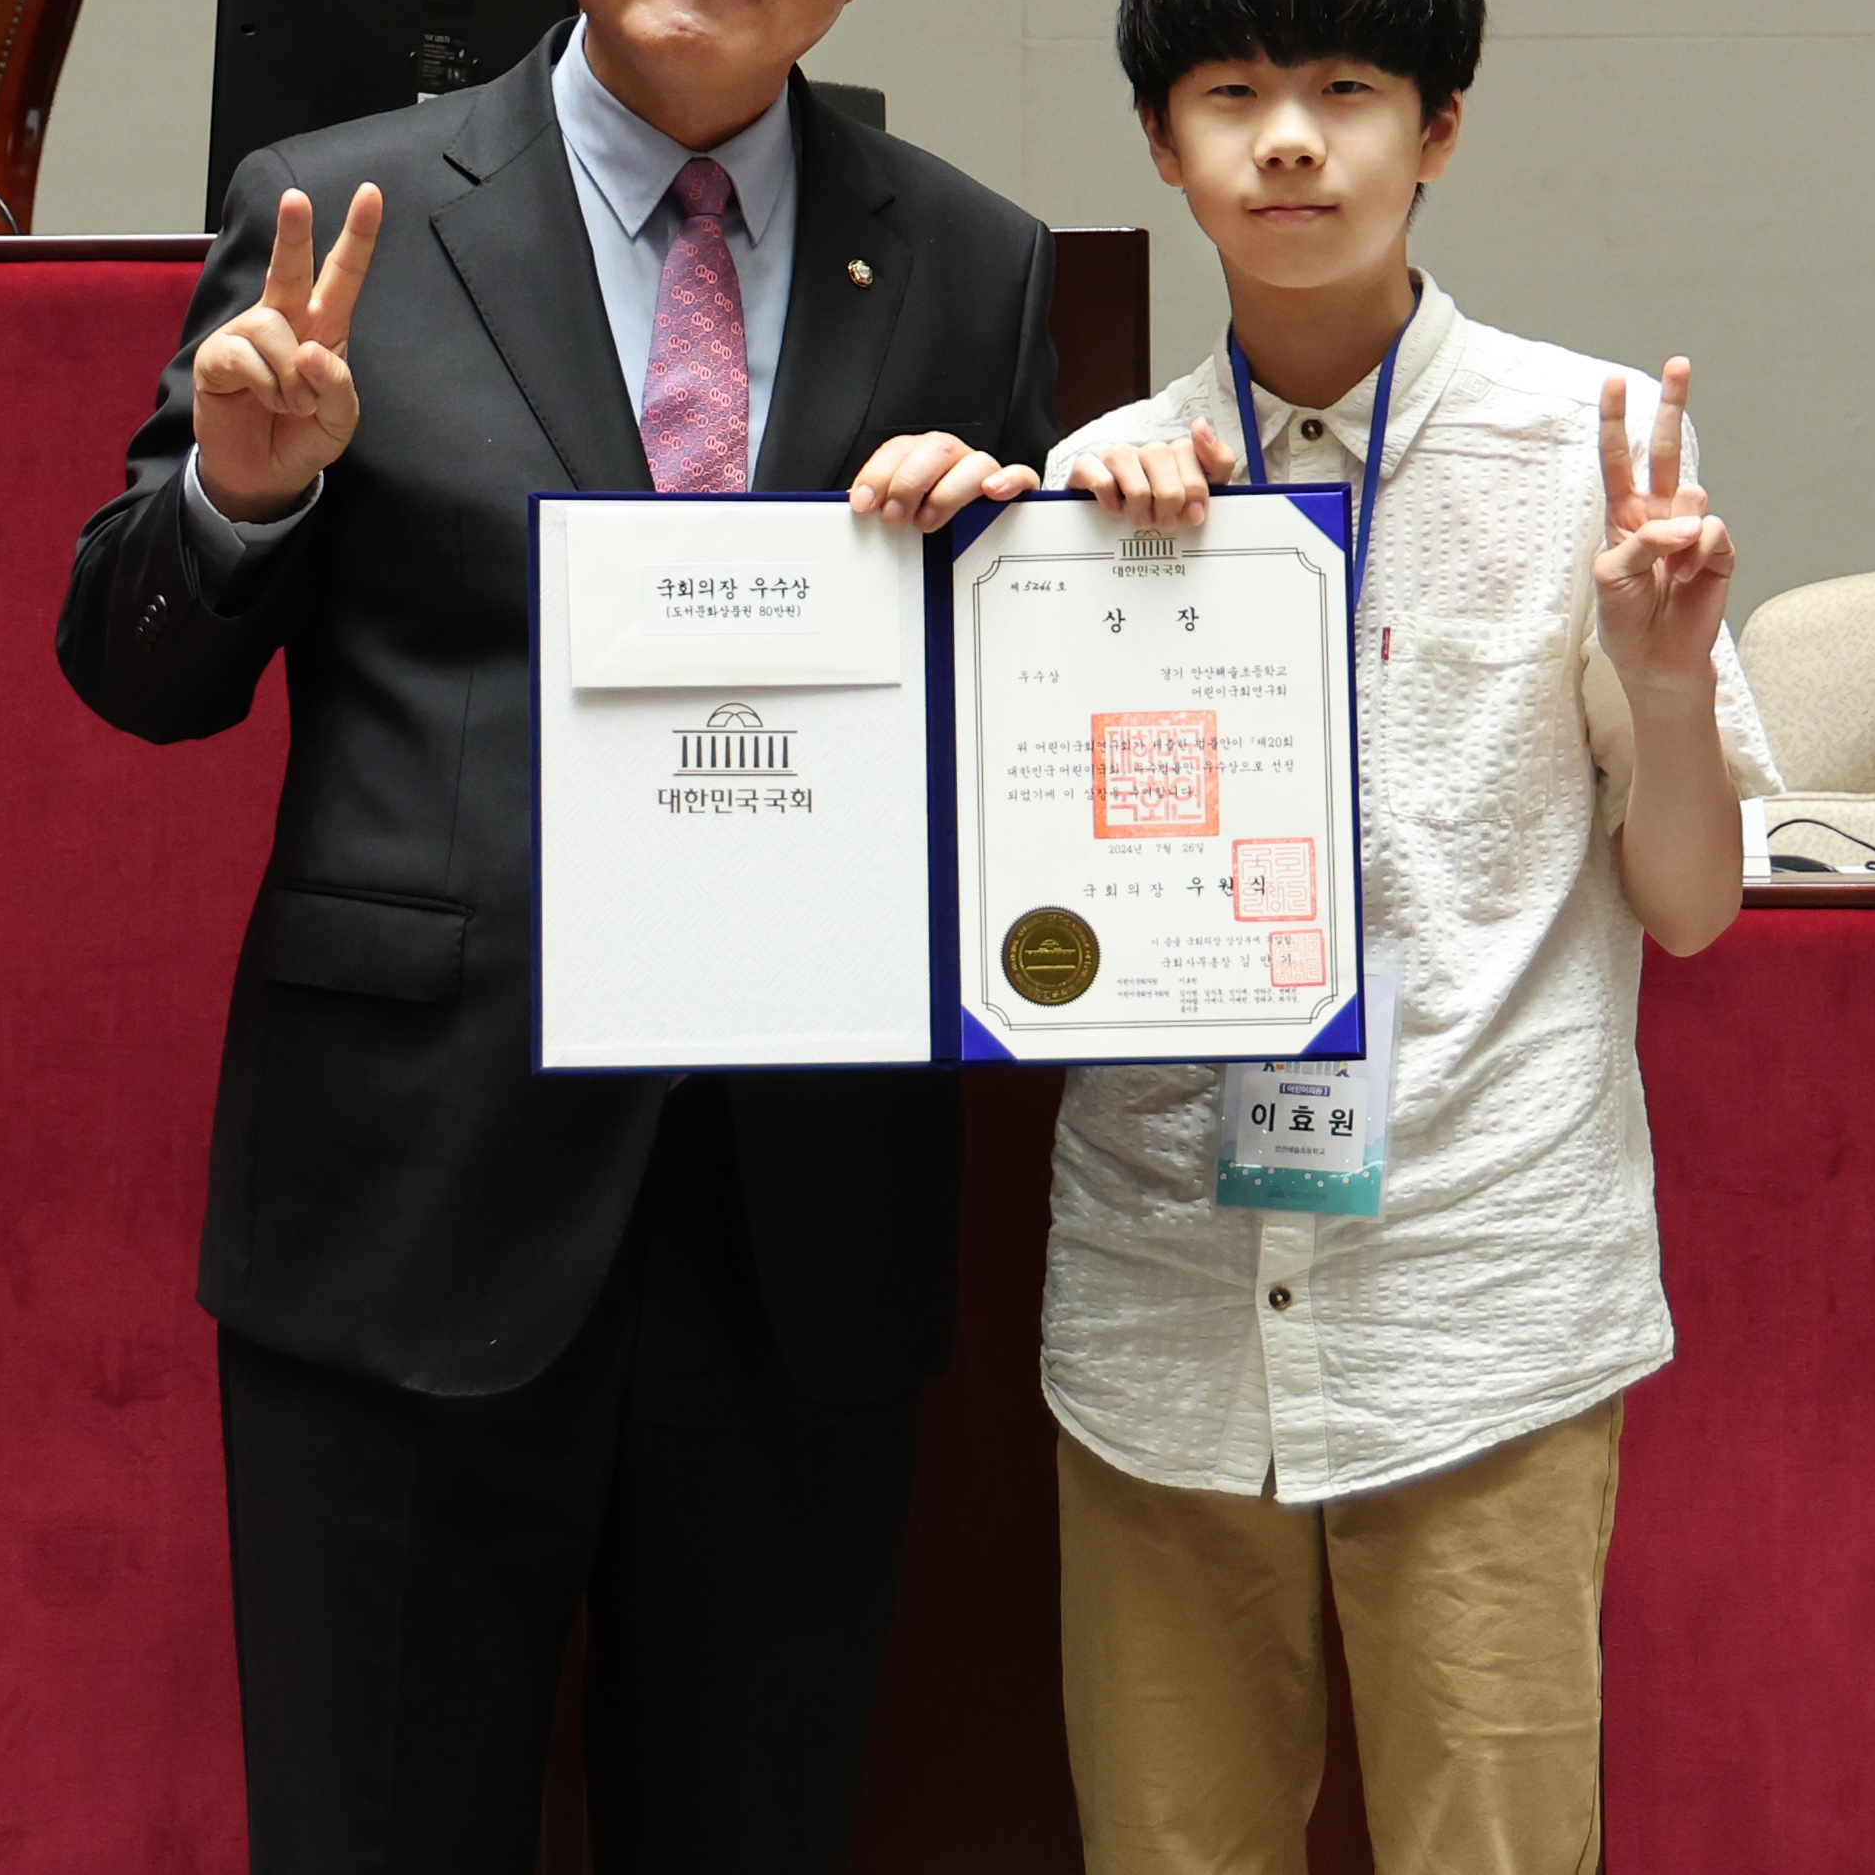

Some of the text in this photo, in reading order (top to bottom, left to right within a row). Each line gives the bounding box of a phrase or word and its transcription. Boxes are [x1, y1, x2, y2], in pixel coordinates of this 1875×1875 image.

[1113, 564, 1186, 578] 대한민국국회
[657, 577, 811, 601] 국회의장 우수상
[666, 604, 802, 619] (도서문화상품권 80만원)
[1160, 666, 1183, 681] 경기
[1191, 683, 1287, 699] 어린이국회연구회
[1017, 741, 1027, 754] 위
[1272, 759, 1294, 773] 선정
[657, 788, 813, 814] 대한민국국회
[1007, 788, 1055, 802] 되었기에
[1063, 788, 1074, 801] 이
[1108, 842, 1205, 855] 2024년 7월 26일
